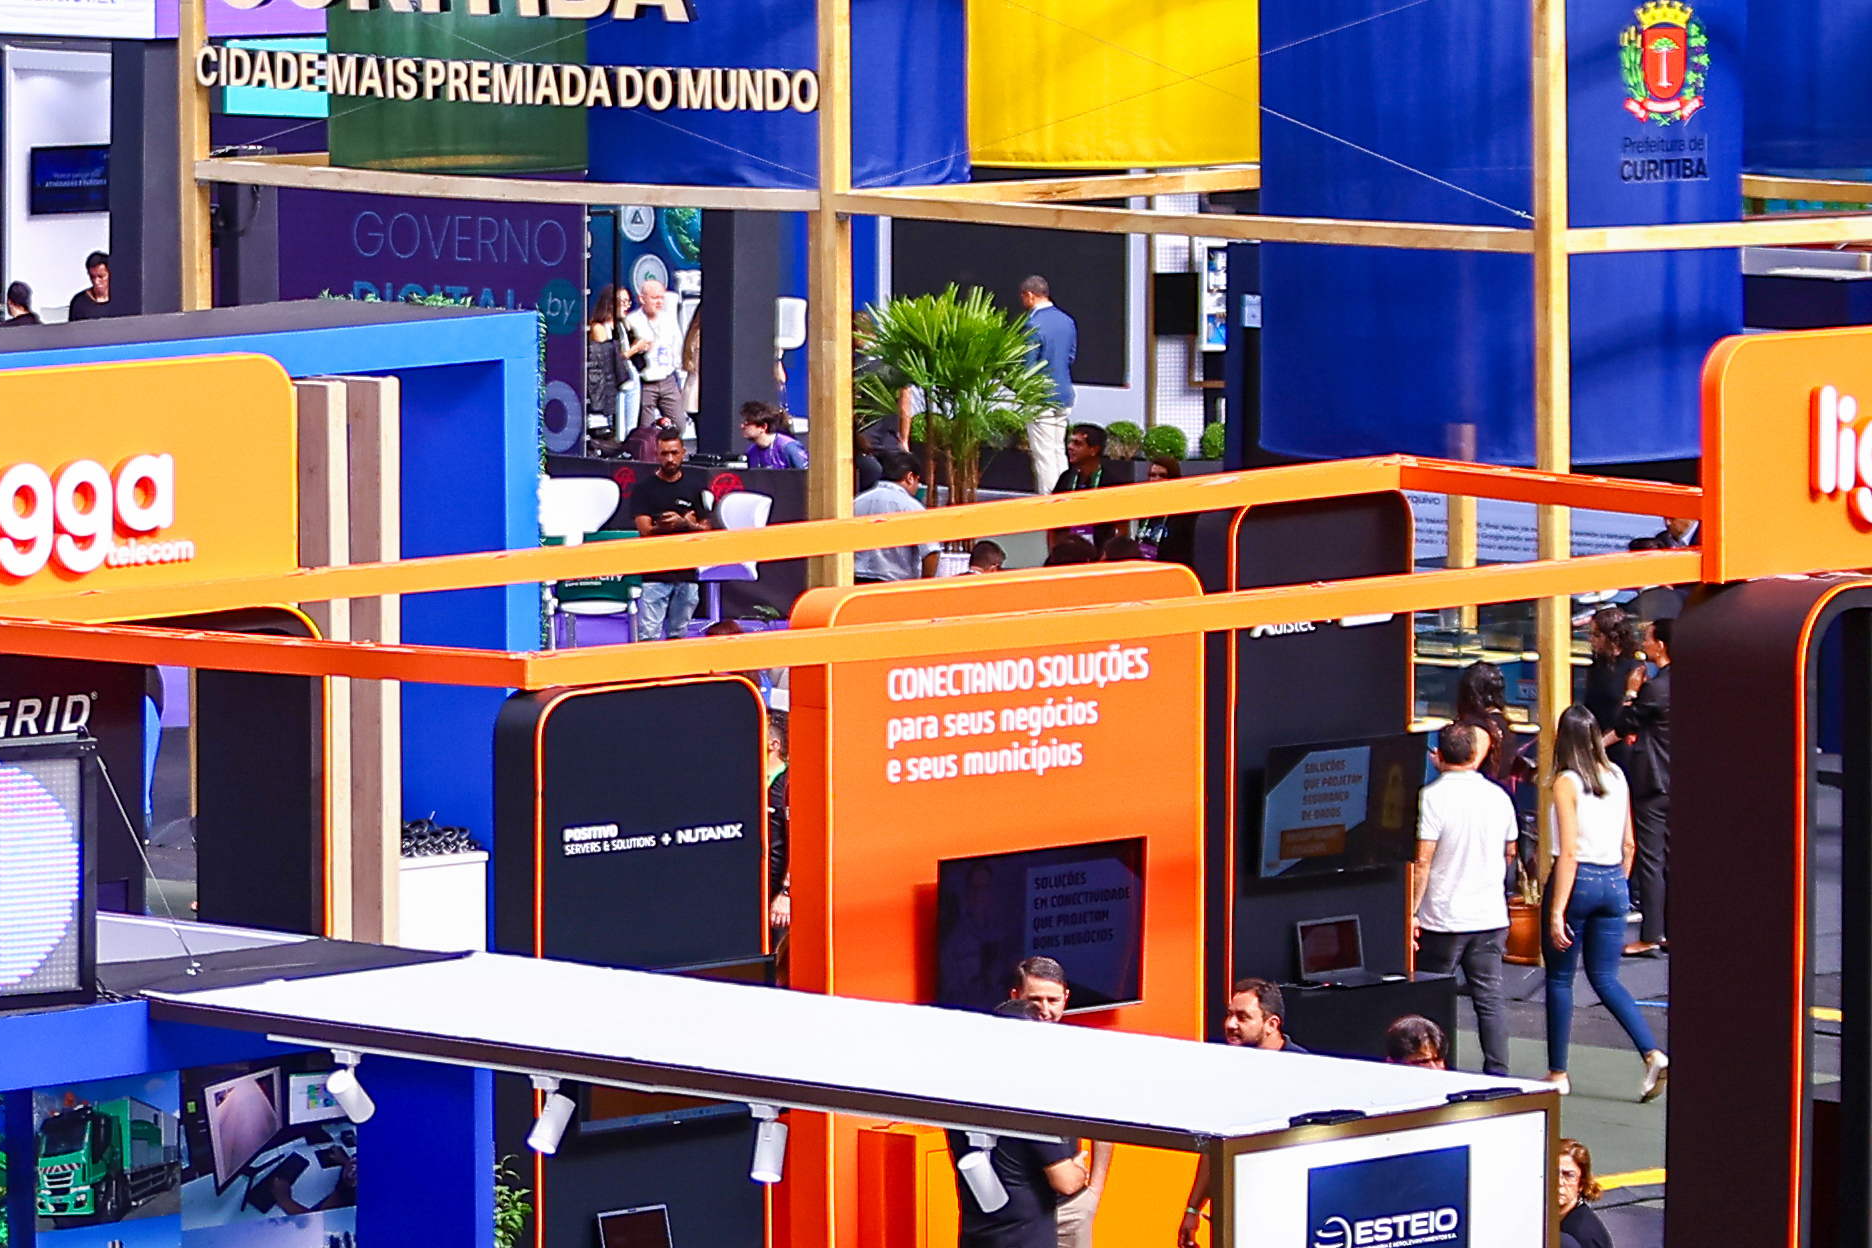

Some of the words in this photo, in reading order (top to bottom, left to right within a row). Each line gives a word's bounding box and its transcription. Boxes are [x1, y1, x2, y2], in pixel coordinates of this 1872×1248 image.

[196, 45, 320, 93] CIDADE
[327, 53, 419, 101] MAIS
[427, 59, 613, 108] PREMIADA
[617, 65, 673, 111] DO
[680, 67, 819, 113] MUNDO
[1621, 158, 1708, 181] CURITIBA
[354, 211, 567, 267] GOVERNO
[1819, 384, 1872, 525] li
[107, 540, 194, 565] telecom
[888, 657, 1035, 701] CONECTANDO
[1037, 643, 1150, 688] SOLUÇÕES
[887, 714, 939, 750] para
[943, 710, 995, 737] seus
[1000, 697, 1099, 737] negócios
[887, 758, 902, 783] e
[906, 754, 958, 782] seus
[963, 737, 1083, 776] municípios
[563, 824, 618, 843] POSITIVO
[564, 842, 601, 856] SERVERS
[612, 835, 657, 851] SOLUTIONS
[675, 823, 743, 844] NUTANIX
[1355, 1207, 1459, 1245] ESTEIO
